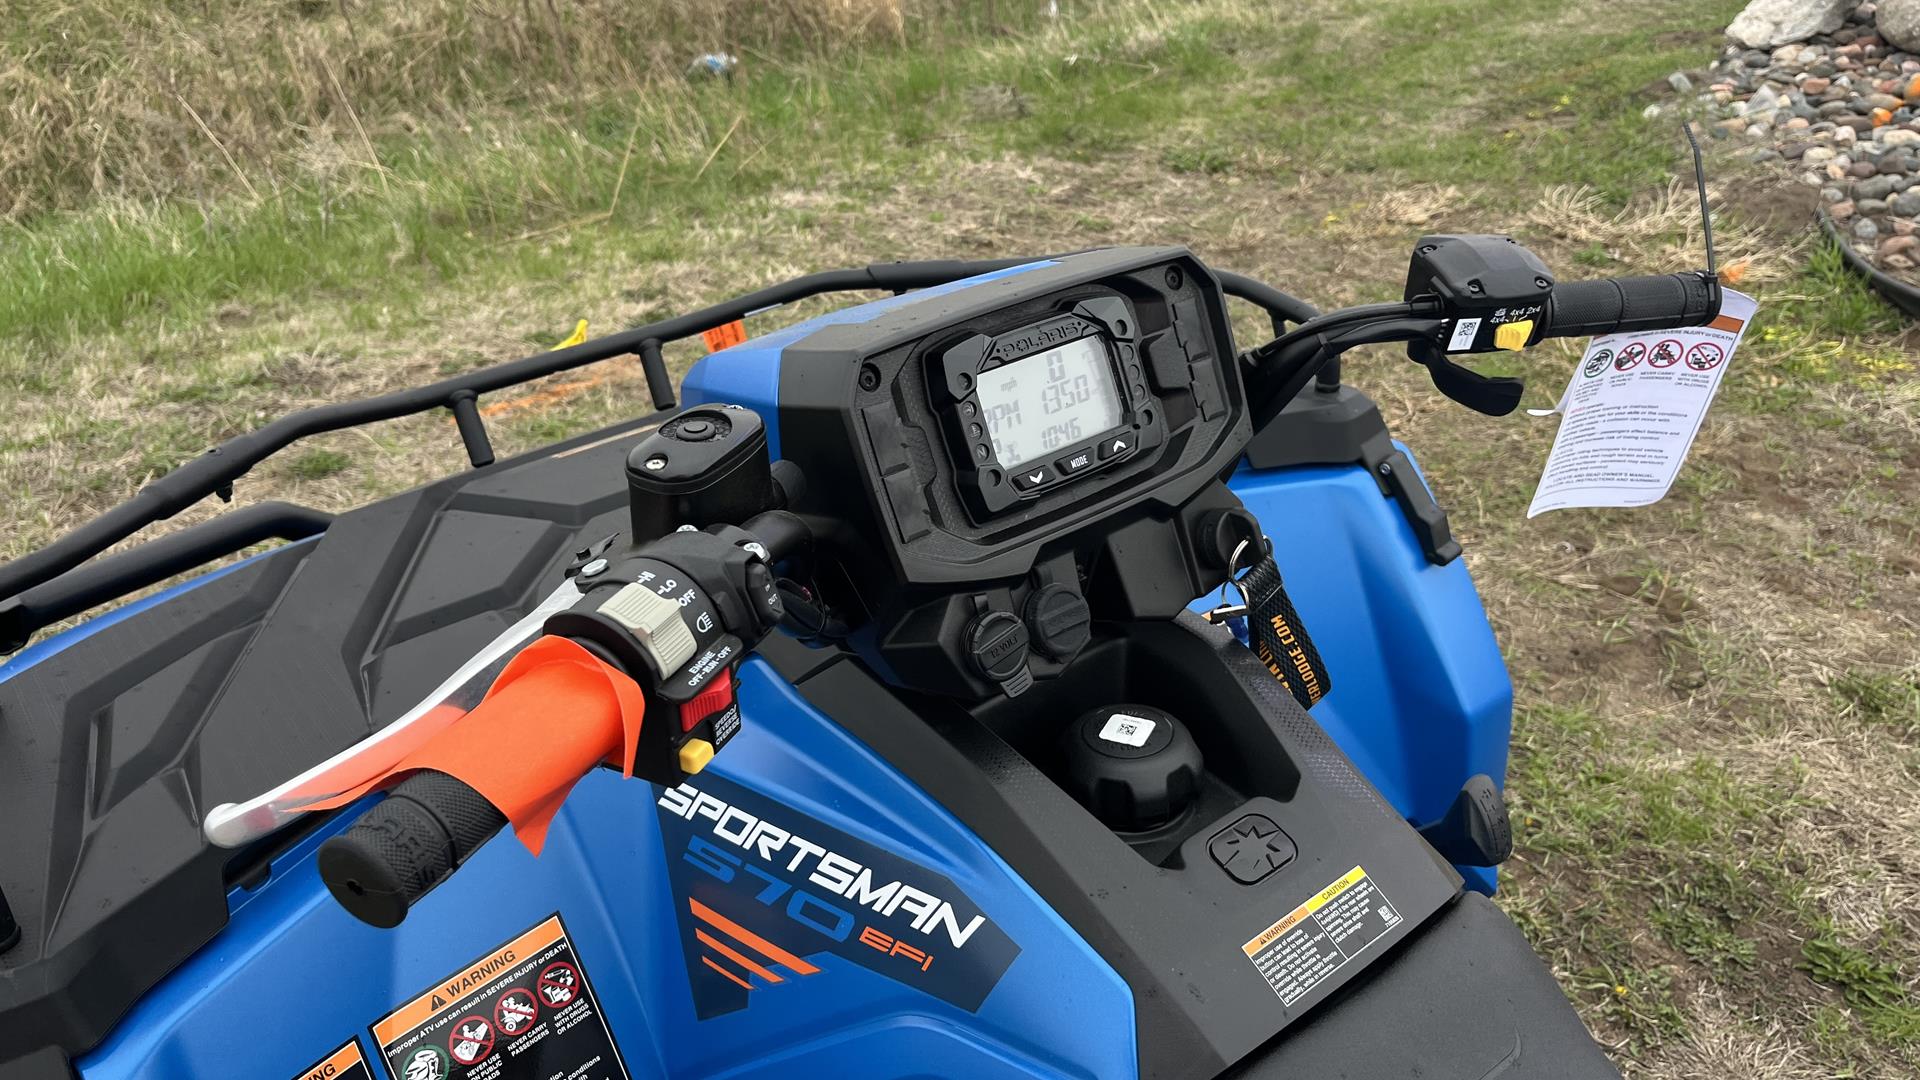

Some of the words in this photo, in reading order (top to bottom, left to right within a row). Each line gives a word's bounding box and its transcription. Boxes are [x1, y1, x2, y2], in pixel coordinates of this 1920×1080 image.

[1510, 308, 1525, 316] 4x4
[1526, 306, 1541, 314] 2x4
[1002, 323, 1078, 356] POLARIS
[1071, 454, 1088, 469] MODE
[638, 571, 656, 582] HI
[660, 580, 677, 592] LO
[679, 589, 695, 606] OFF
[768, 594, 777, 604] OUT
[689, 651, 716, 674] ENGINE
[716, 712, 738, 737] REVERSE
[716, 718, 740, 745] OVERRIDE
[658, 783, 986, 948] SPORTSMAN
[1322, 878, 1349, 900] CAUTION
[682, 835, 854, 942] 570
[859, 926, 934, 972] EFI
[1264, 916, 1296, 940] WARNING
[1313, 932, 1325, 942] injury
[446, 950, 515, 996] WARNING
[387, 1034, 419, 1057] Improper
[420, 1024, 434, 1038] ATV
[434, 1017, 448, 1028] use
[447, 1009, 461, 1020] can
[460, 996, 480, 1012] result
[486, 975, 514, 996] SEVERE
[513, 960, 537, 979] INJURY
[544, 942, 567, 960] DEATH
[553, 1006, 573, 1021] NEVER
[572, 998, 584, 1008] USE
[554, 1016, 569, 1028] WITH
[569, 1003, 589, 1019] DRUGS
[557, 1026, 566, 1035] OR
[566, 1010, 592, 1029] ALCOHOL
[507, 1035, 527, 1051] NEVER
[527, 1022, 546, 1038] CARRY
[511, 1029, 549, 1056] PASSENGERS
[466, 1061, 487, 1078] NEVER
[487, 1053, 500, 1064] USE
[480, 1060, 502, 1077] PUBLIC
[568, 1056, 600, 1080] conditions
